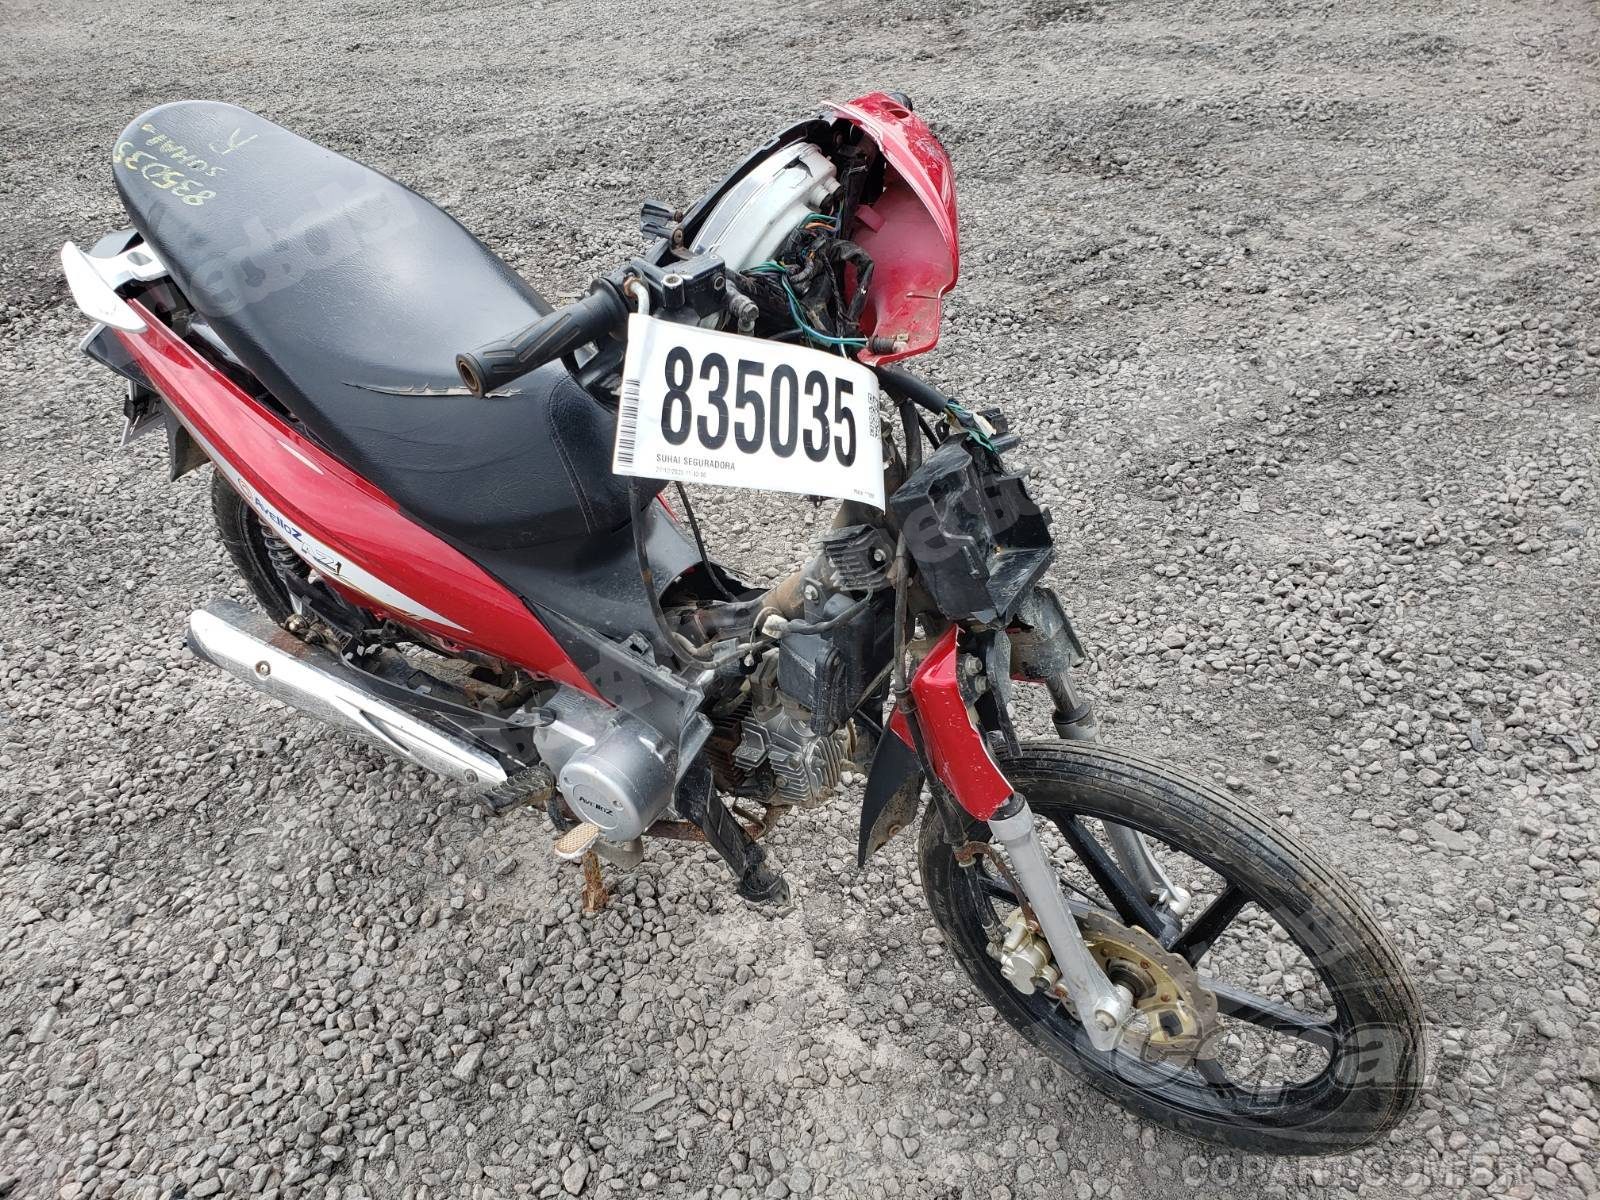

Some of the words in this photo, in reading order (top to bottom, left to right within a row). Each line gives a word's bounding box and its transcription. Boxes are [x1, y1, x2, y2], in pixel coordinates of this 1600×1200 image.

[660, 345, 857, 468] 835035
[656, 453, 681, 465] SUHAI
[683, 456, 736, 471] SEGURADORA
